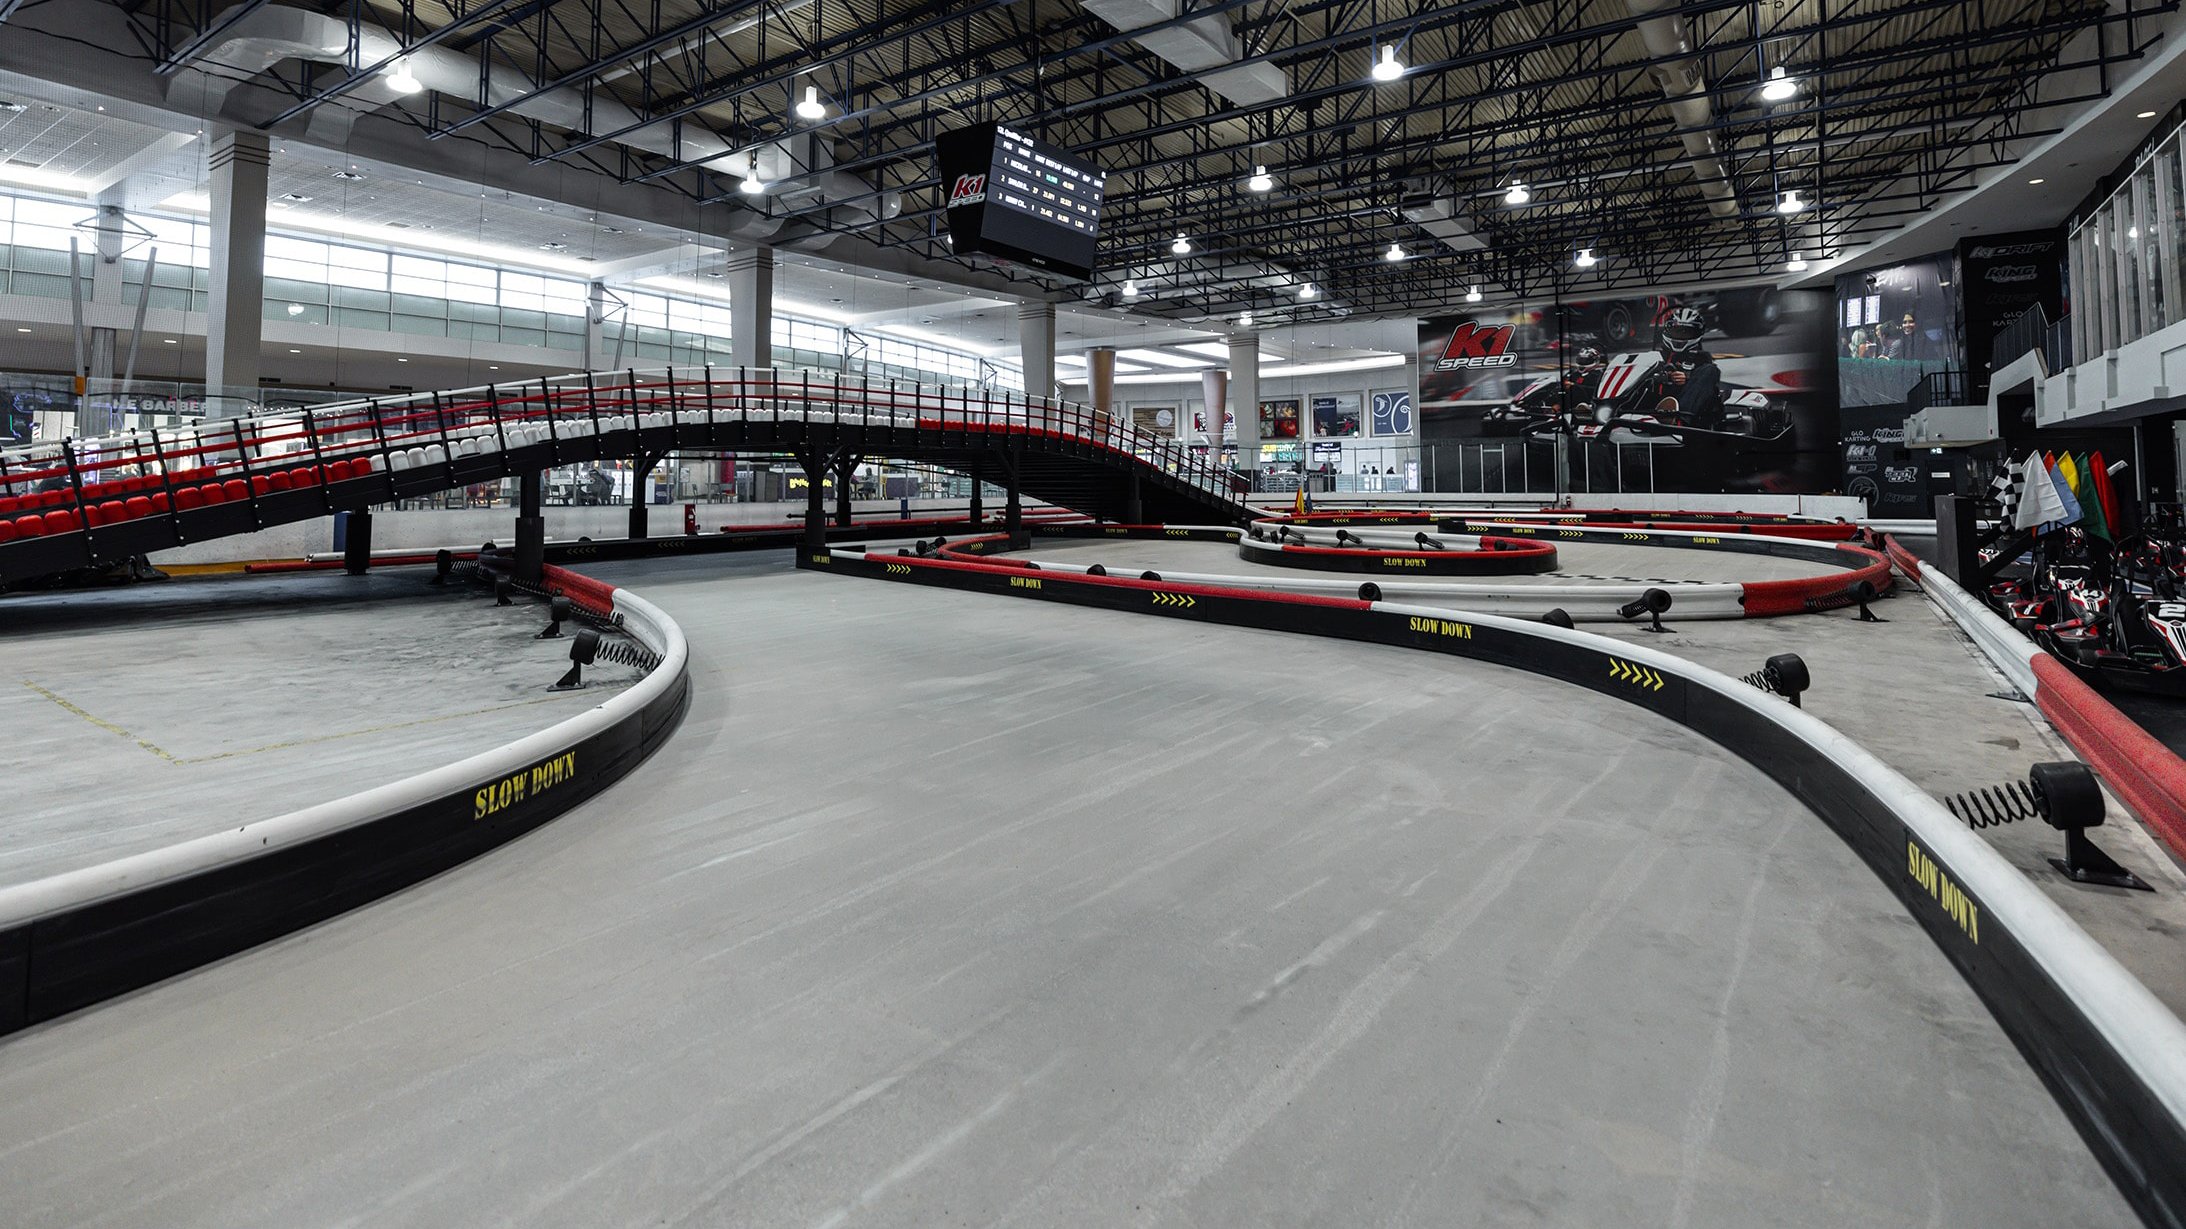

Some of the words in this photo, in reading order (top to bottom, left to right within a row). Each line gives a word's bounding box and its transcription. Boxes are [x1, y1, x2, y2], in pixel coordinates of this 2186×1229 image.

[952, 174, 985, 200] K1
[1443, 320, 1516, 358] K1
[1438, 355, 1516, 369] SPEED
[1384, 558, 1403, 566] SLOW
[1404, 558, 1426, 566] DOWN
[1010, 576, 1024, 586] SLOW
[1026, 578, 1041, 589] DOWN
[1410, 616, 1439, 634] SLOW
[1441, 620, 1472, 640] DOWN
[474, 772, 528, 820] SLOW
[532, 751, 576, 795] DOWN
[1908, 842, 1938, 900] SLOW
[1941, 872, 1978, 945] DOWN
